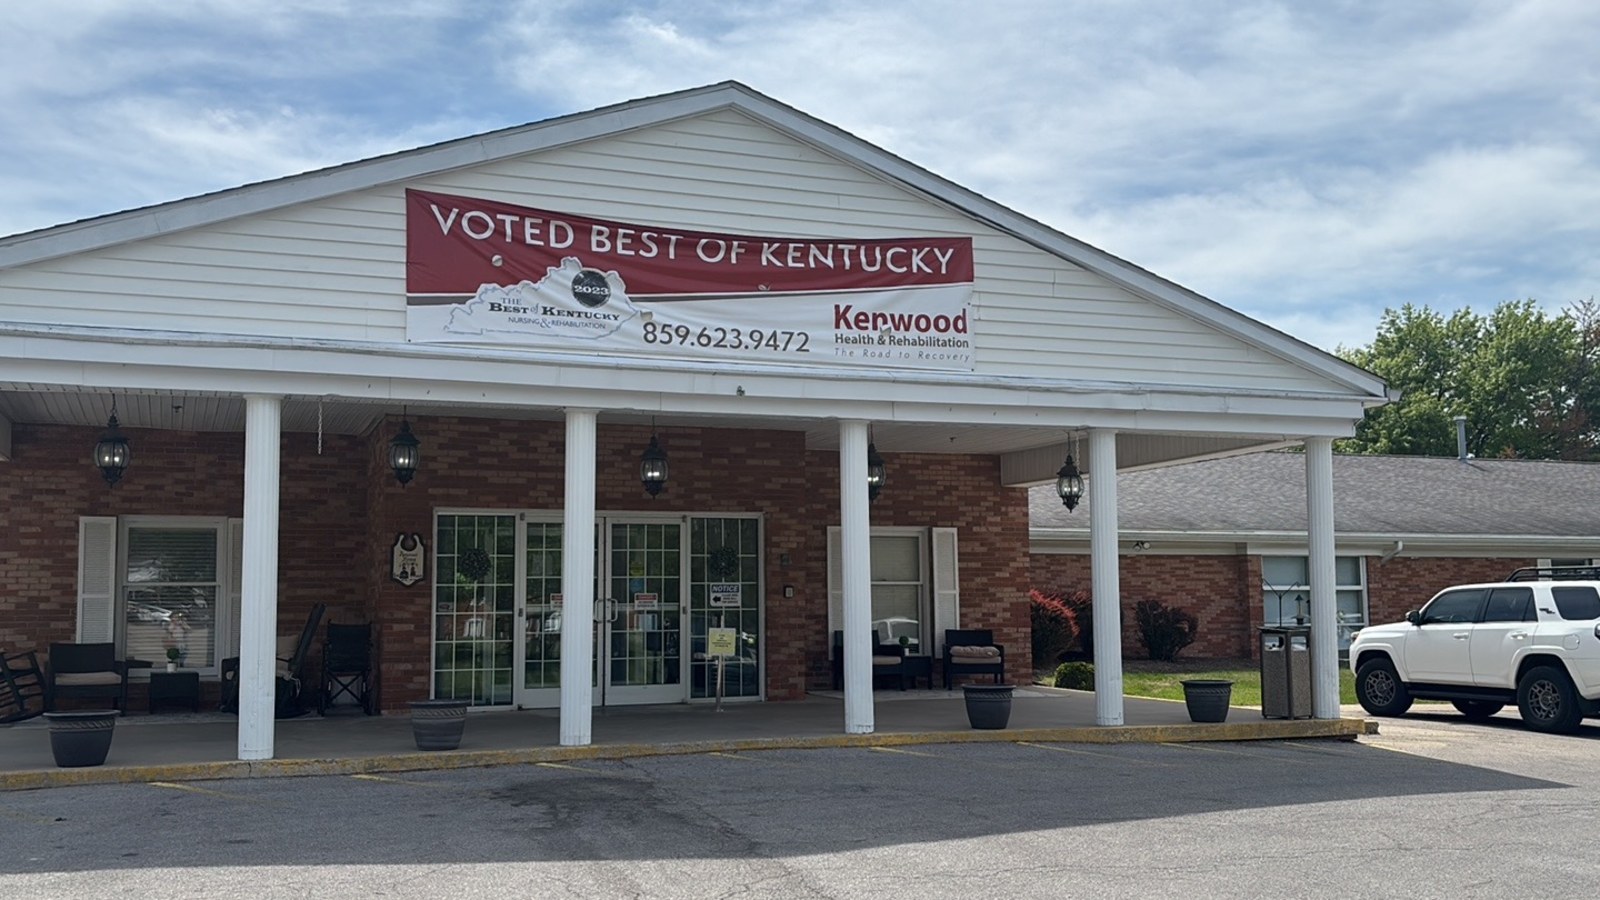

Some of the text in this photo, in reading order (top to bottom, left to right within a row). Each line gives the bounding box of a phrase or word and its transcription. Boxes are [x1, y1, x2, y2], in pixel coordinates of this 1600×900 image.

[431, 204, 954, 274] VOTED BEST OF KENTUCKY
[574, 284, 609, 296] 2023
[488, 301, 529, 315] BEST
[530, 303, 540, 314] of
[501, 297, 522, 305] THE
[508, 316, 540, 325] NURSING
[551, 319, 606, 329] REHABILITATION
[834, 304, 968, 335] Kenwood
[643, 321, 811, 353] 859.623.9472
[834, 333, 969, 349] Health & Rehabilitation
[834, 348, 970, 363] The Road to Recovery
